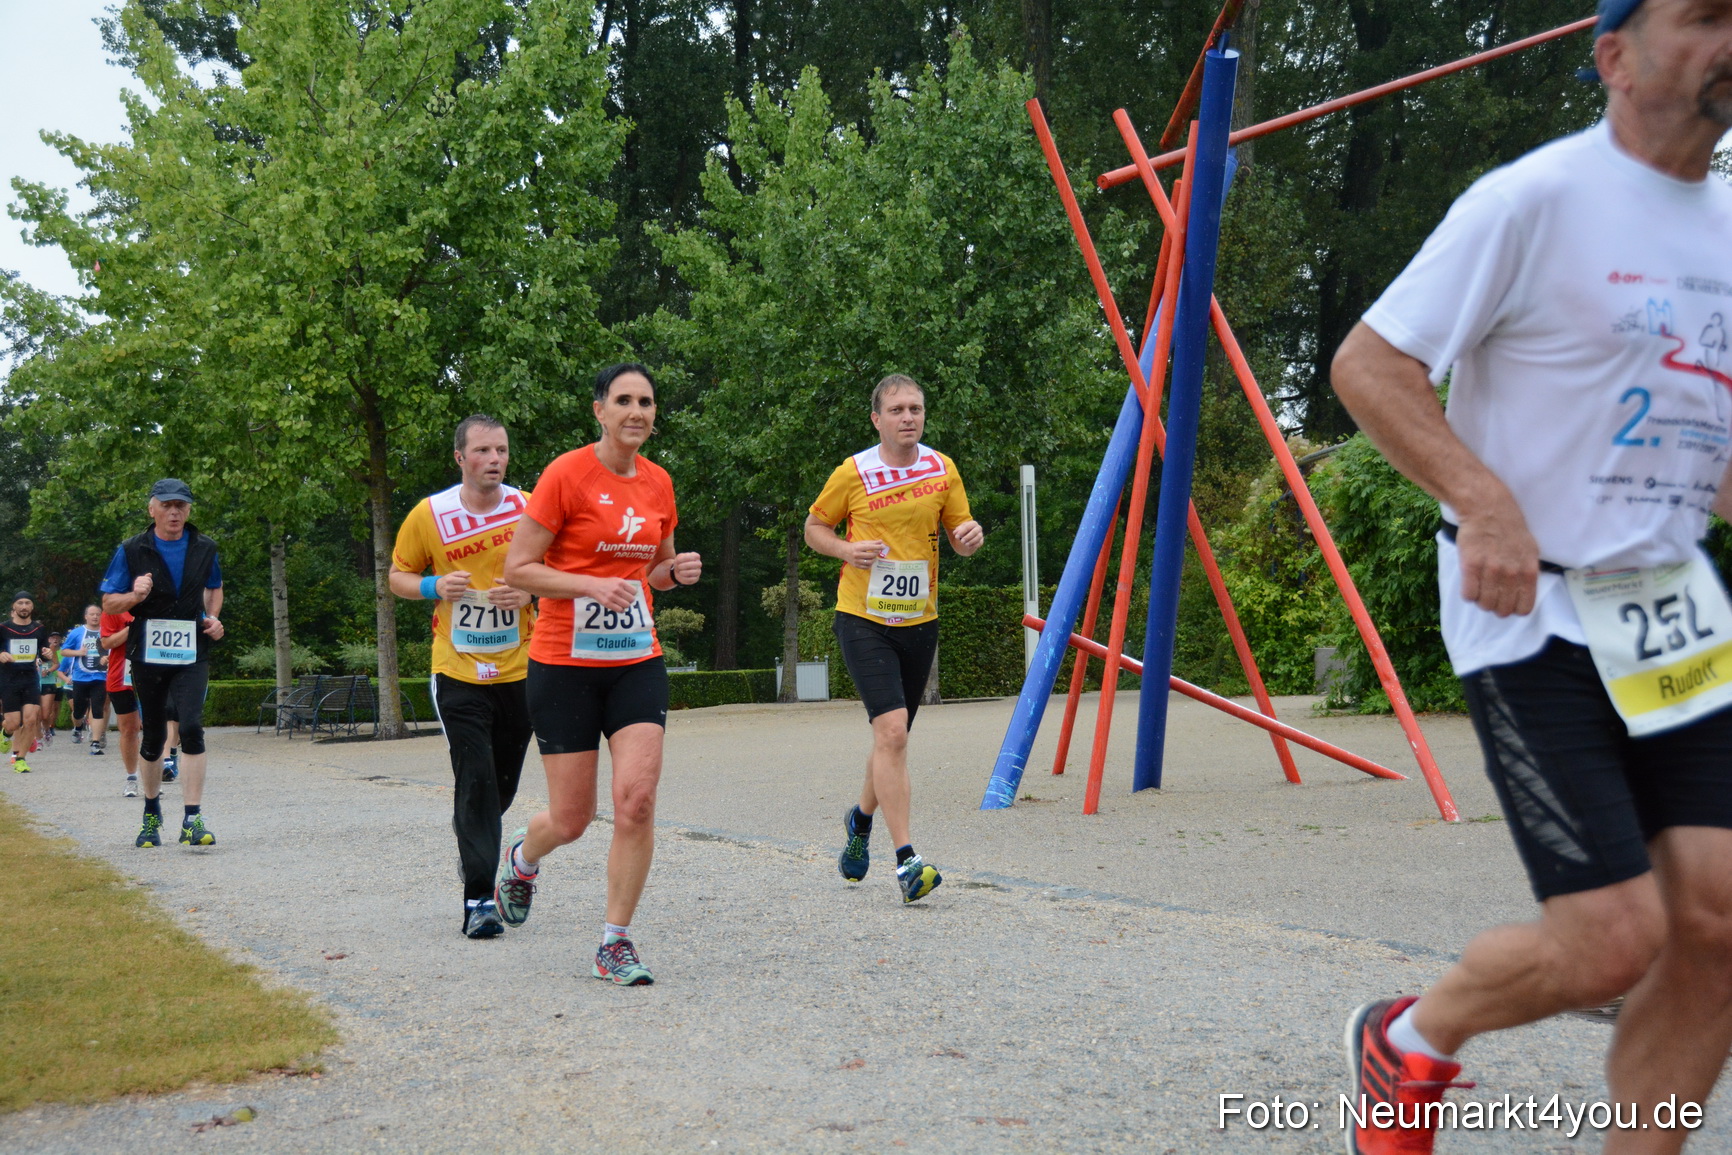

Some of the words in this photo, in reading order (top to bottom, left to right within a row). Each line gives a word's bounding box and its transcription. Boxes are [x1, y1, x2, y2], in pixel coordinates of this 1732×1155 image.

[868, 491, 908, 511] MAX
[911, 480, 949, 499] BÖGL
[446, 539, 488, 562] MAX
[492, 528, 515, 547] BÖ
[595, 541, 657, 553] funrunners
[881, 574, 920, 597] 290
[878, 601, 918, 612] Siegmund
[459, 604, 515, 629] 2710
[584, 600, 646, 630] 2531
[152, 630, 191, 648] 2021
[466, 634, 507, 645] Christian
[596, 637, 637, 649] Claudia
[19, 644, 31, 654] 59
[160, 651, 184, 659] Werner
